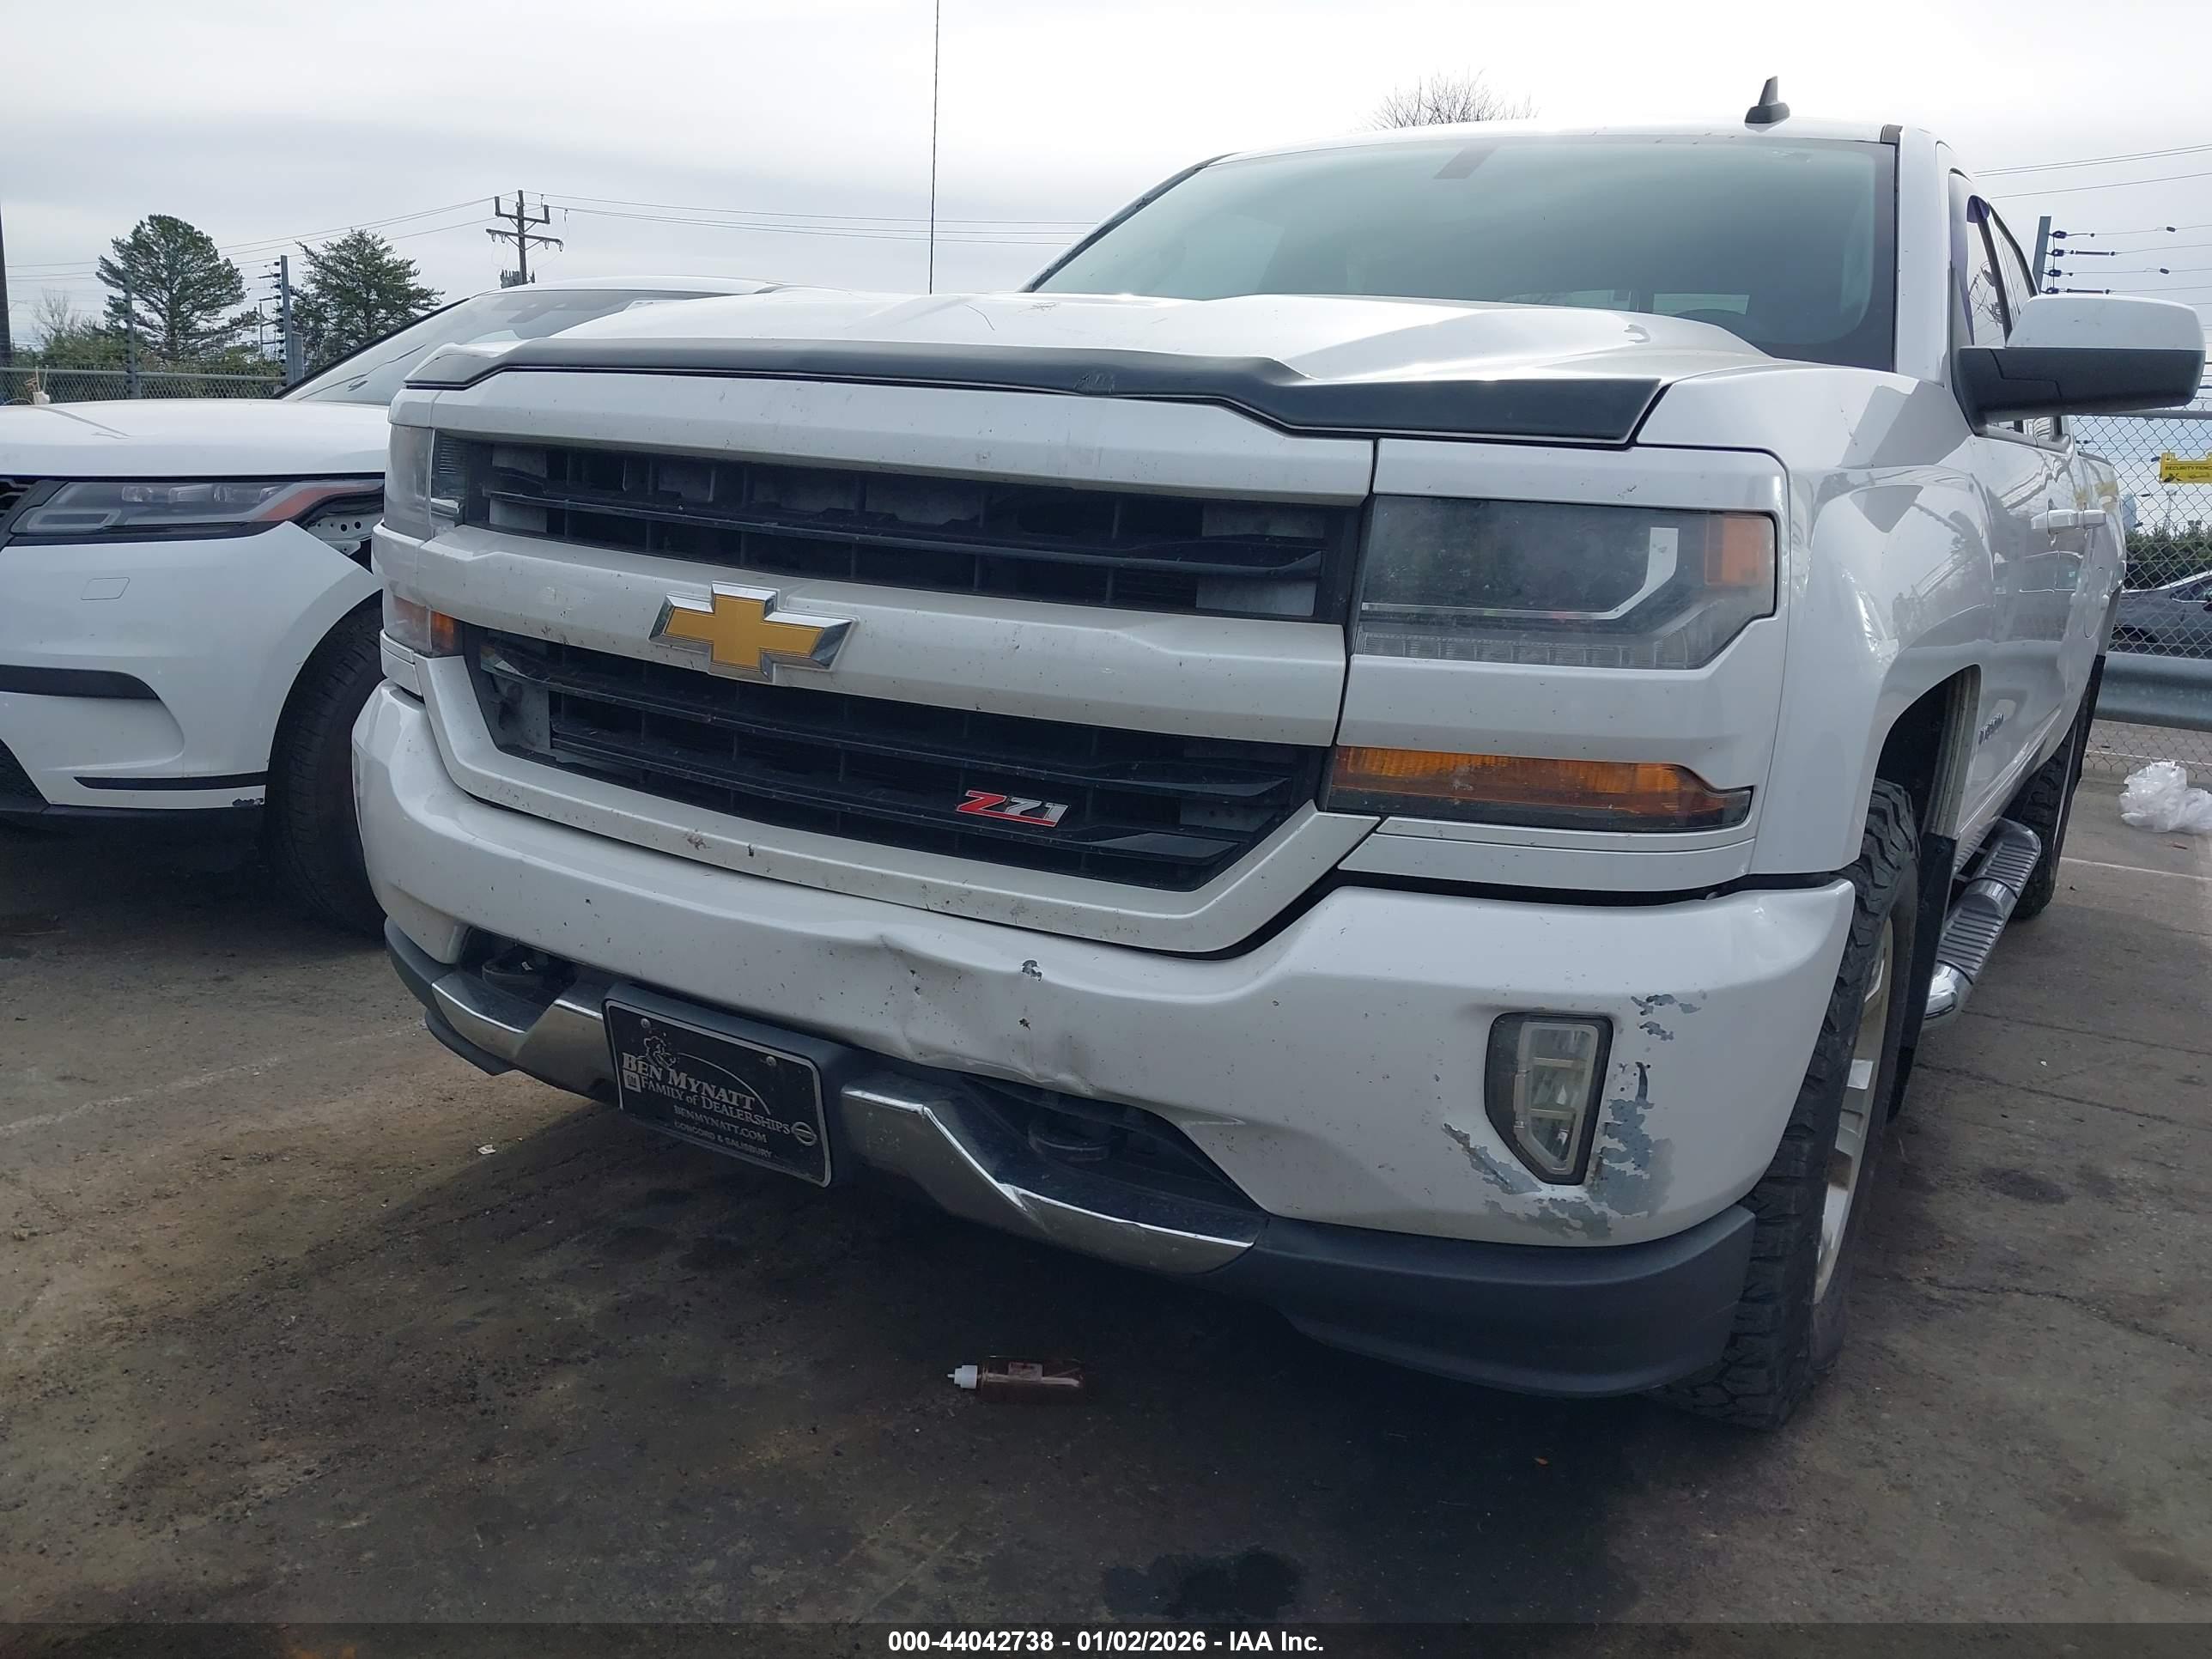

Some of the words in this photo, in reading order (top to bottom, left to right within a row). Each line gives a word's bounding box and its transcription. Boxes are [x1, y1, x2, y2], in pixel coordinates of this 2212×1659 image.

[957, 790, 1069, 827] Z71
[623, 1052, 662, 1081] BEN
[669, 1068, 755, 1110] MYNATT
[641, 1076, 684, 1101] FAMILY
[687, 1095, 698, 1106] of
[701, 1096, 791, 1135] DEALERSHIPS
[673, 1104, 768, 1143] BENMYNATT.COM
